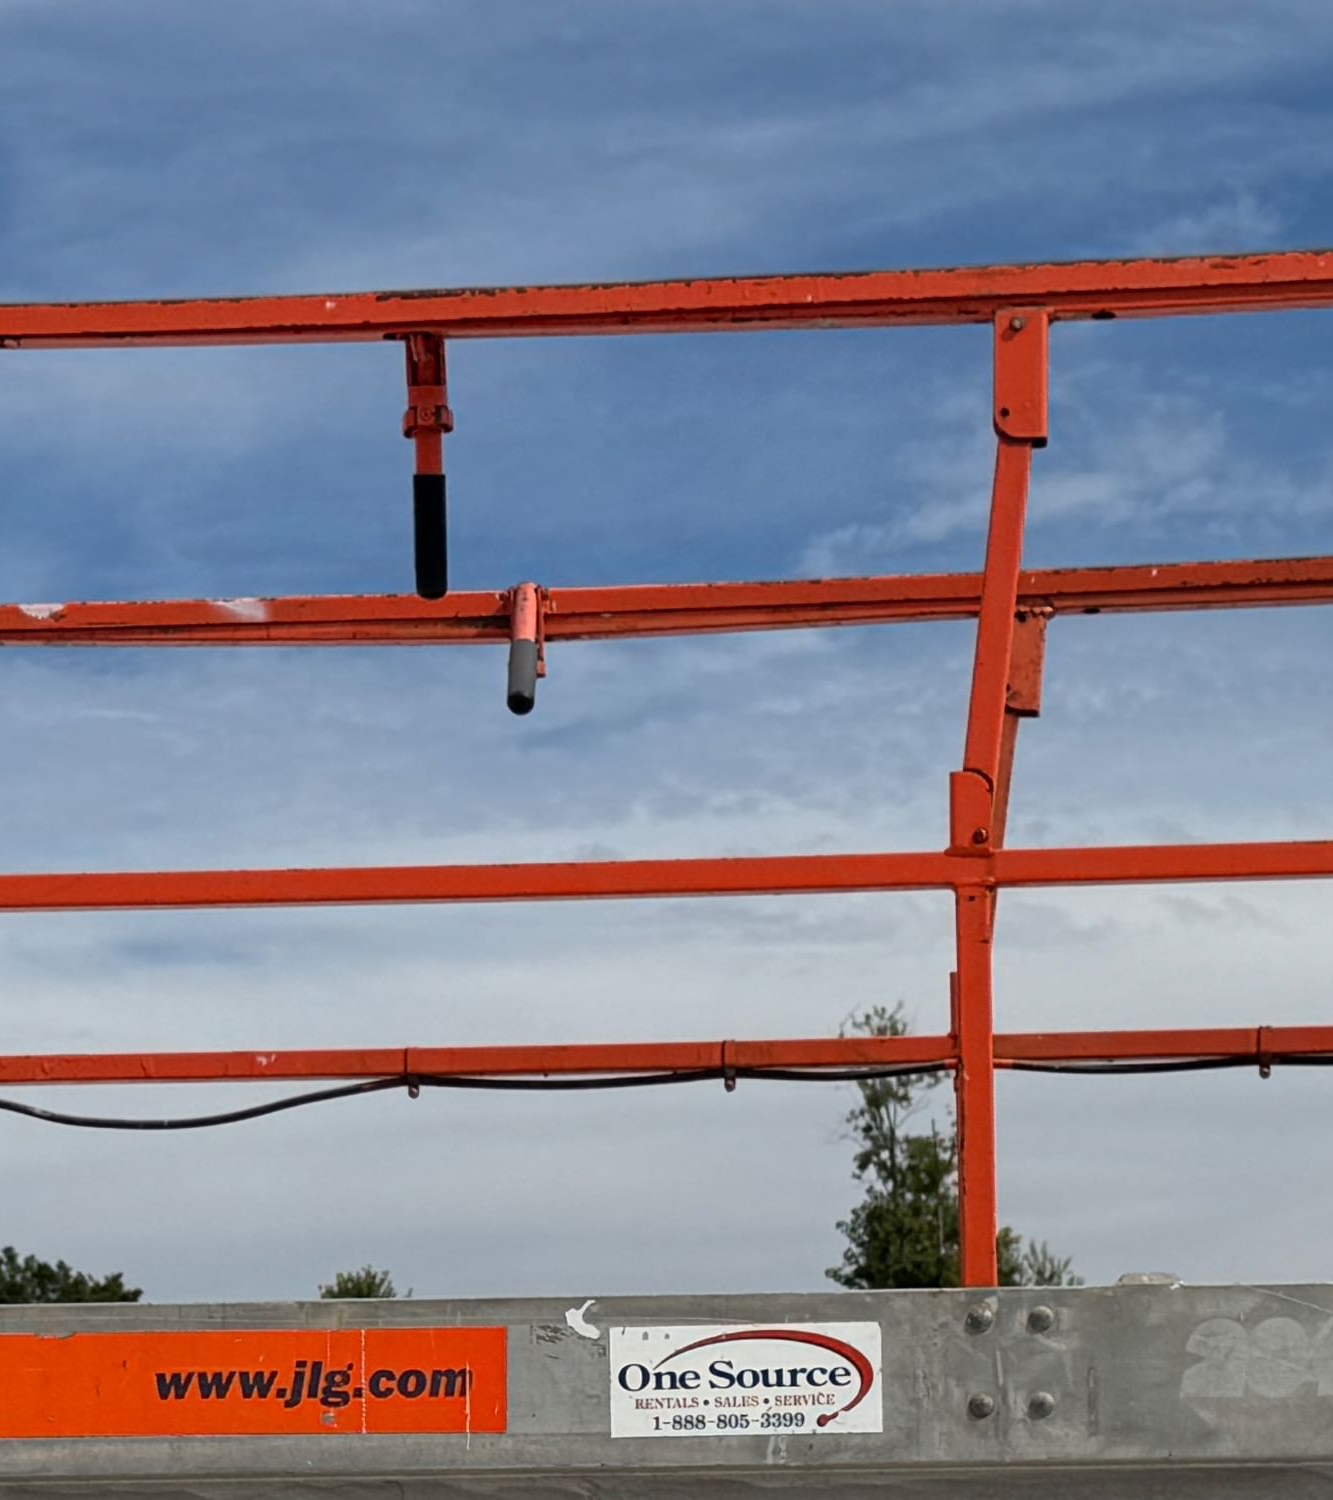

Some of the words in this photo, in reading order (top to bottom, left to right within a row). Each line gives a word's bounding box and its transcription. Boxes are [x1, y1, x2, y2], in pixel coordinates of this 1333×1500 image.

[155, 1360, 473, 1408] www.jlg.com
[618, 1363, 701, 1391] One
[708, 1360, 851, 1389] Source
[634, 1396, 700, 1410] RENTALS
[714, 1394, 760, 1408] SALES
[774, 1393, 835, 1407] SERVICE
[653, 1411, 806, 1431] 1-888-805-3399
